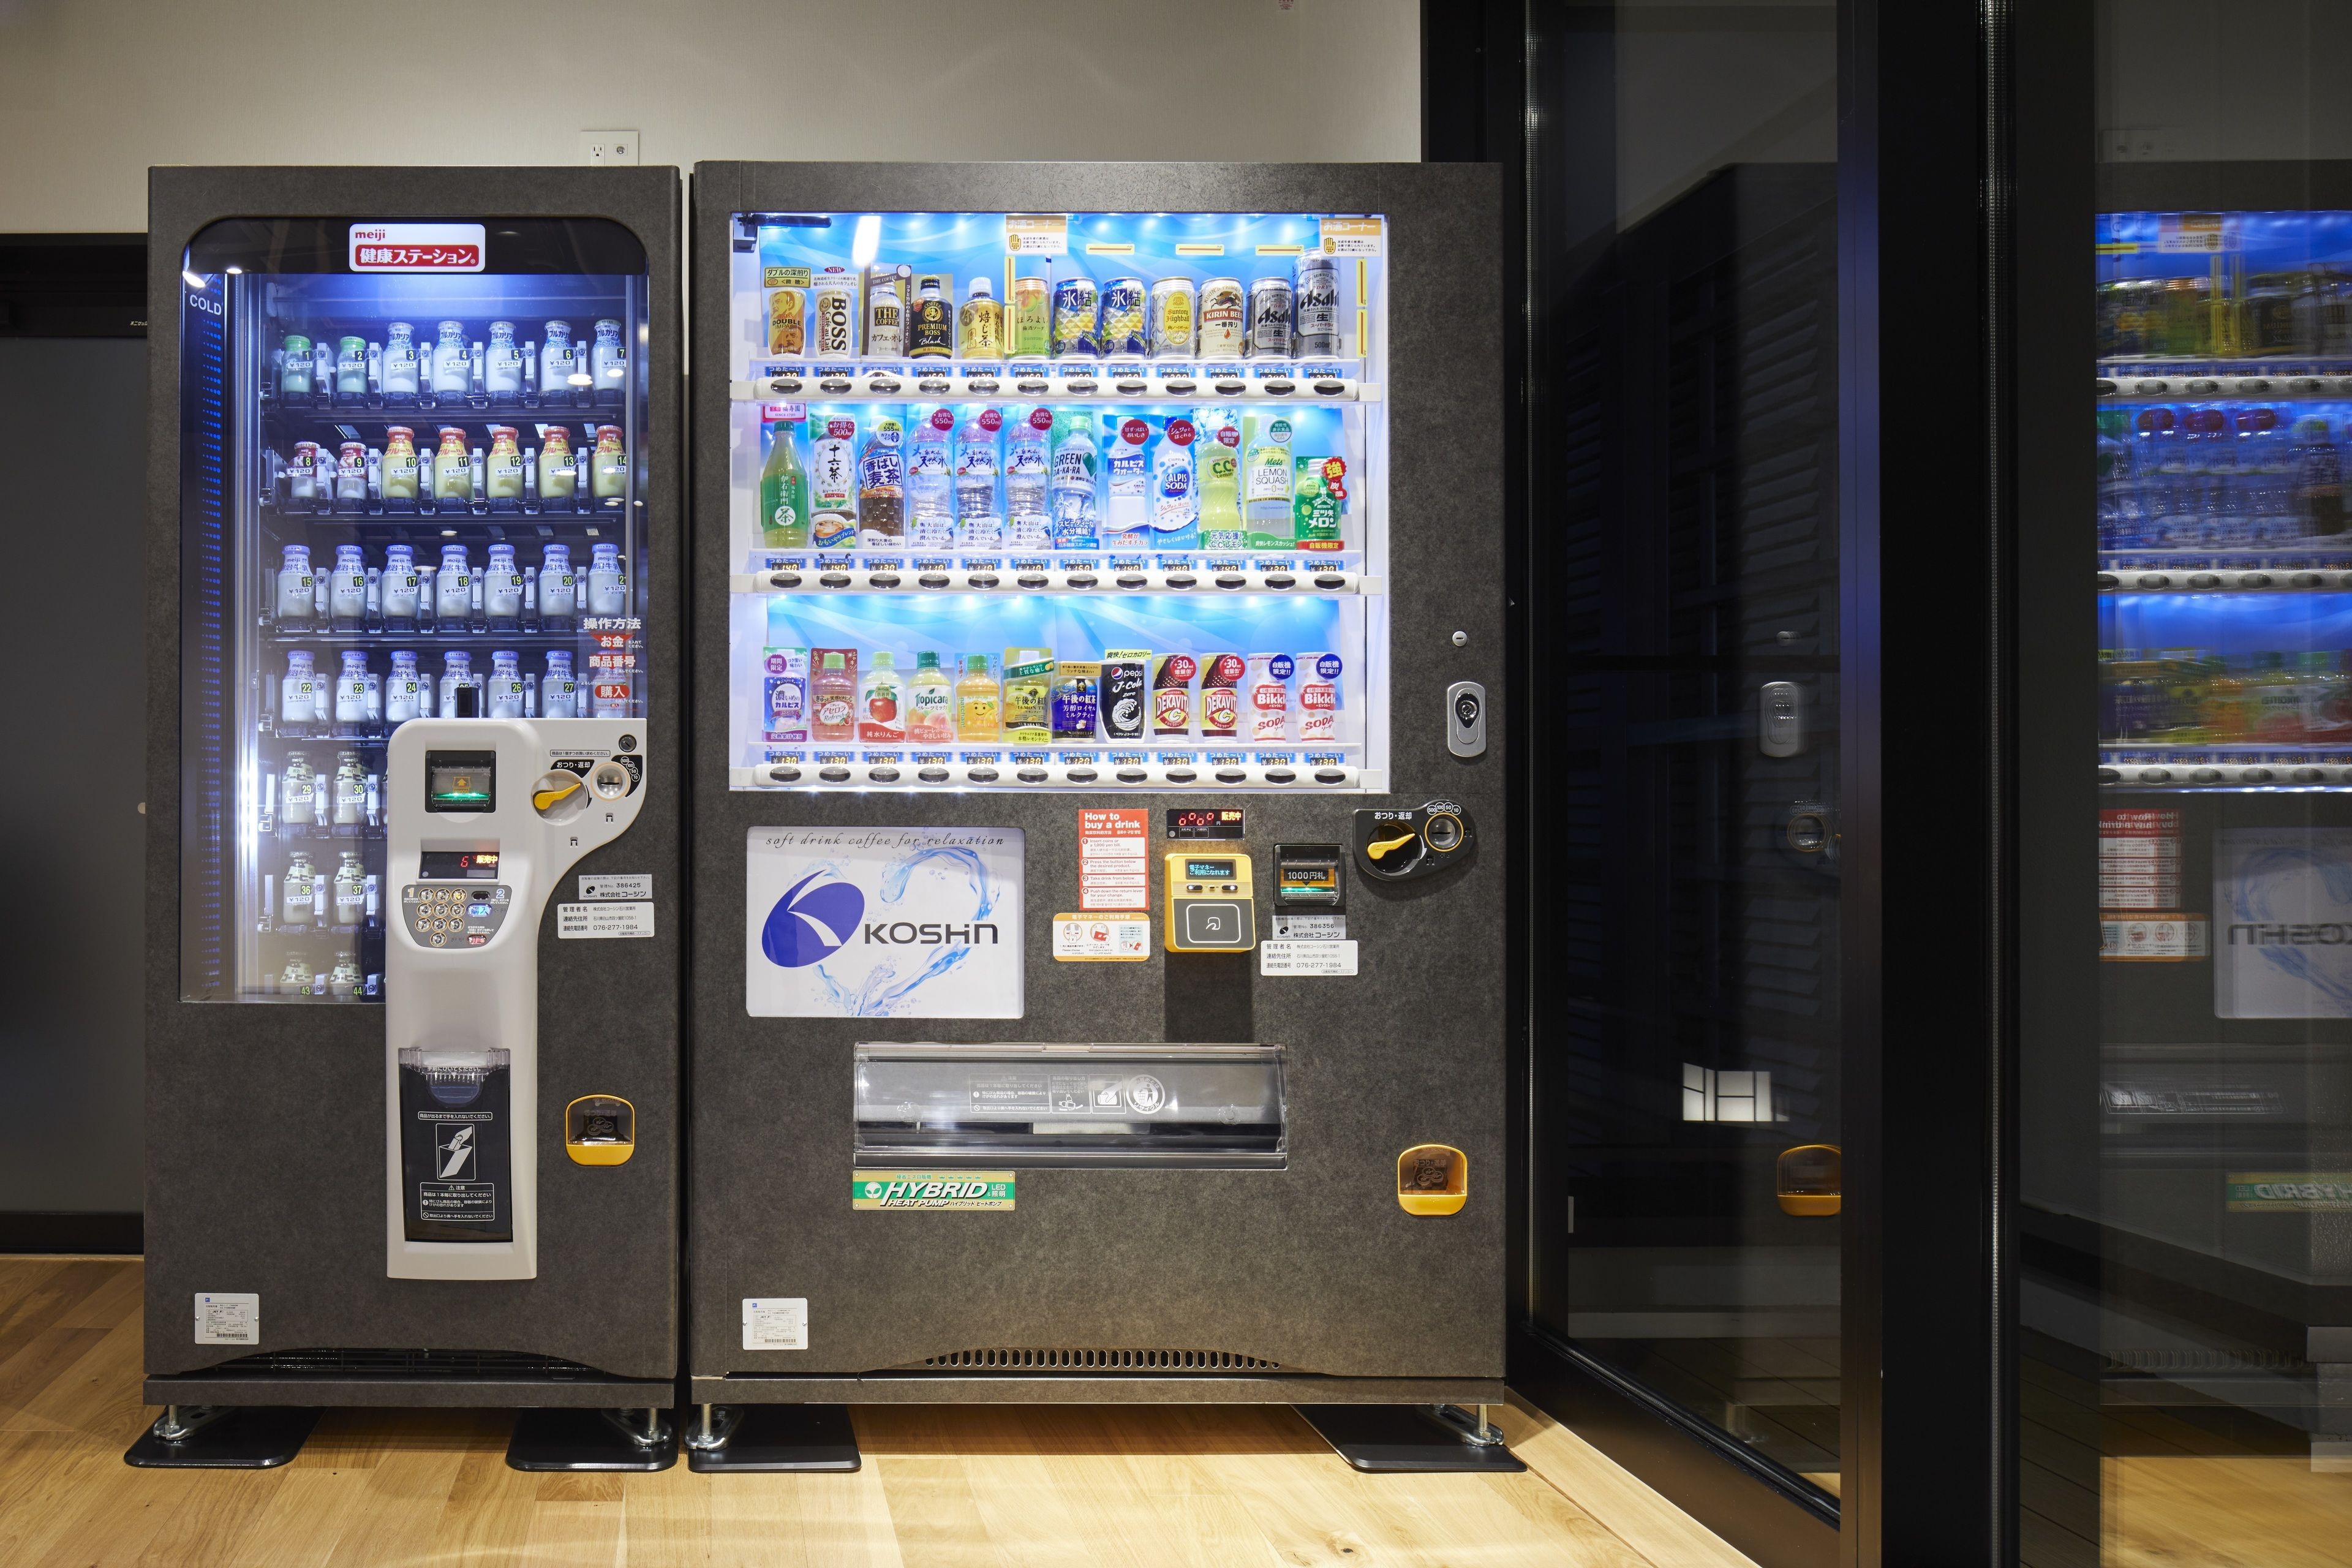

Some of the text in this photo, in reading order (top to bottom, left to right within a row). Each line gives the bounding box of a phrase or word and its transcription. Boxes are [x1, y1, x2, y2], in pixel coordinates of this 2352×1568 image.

[1324, 222, 1376, 232] お酒コーナー
[355, 229, 386, 241] meiji
[360, 247, 472, 264] 健康ステーション
[1062, 291, 1092, 307] 氷結
[1112, 291, 1140, 307] 氷結
[190, 295, 222, 315] COLD
[876, 308, 899, 318] THE
[1167, 309, 1188, 318] Suntory
[831, 296, 846, 351] BOSS
[979, 311, 993, 347] 焙じ茶
[919, 336, 946, 345] Black
[305, 351, 309, 360] 1
[409, 350, 414, 360] 3
[513, 350, 519, 360] 5
[565, 350, 571, 359] 6
[619, 349, 625, 358] 7
[306, 457, 311, 466] 8
[565, 457, 574, 466] 13
[827, 444, 842, 483] 十六茶
[919, 456, 948, 468] 天然水
[966, 456, 995, 469] 天然水
[1015, 456, 1044, 467] 天然水
[1054, 453, 1082, 468] GREEN
[1212, 460, 1234, 474] C.C.
[1325, 462, 1343, 478] 強
[868, 469, 900, 486] 麦茶
[1165, 473, 1186, 483] CALPIS
[1165, 481, 1186, 490] SODA
[777, 508, 794, 523] 茶
[1309, 518, 1337, 528] メロン
[818, 530, 854, 546] おもいやりブレンド
[407, 577, 417, 586] 17
[583, 617, 641, 630] 操作方法
[600, 636, 624, 647] お金
[589, 655, 636, 668] 商品番号
[1124, 669, 1143, 678] pepsi
[407, 684, 417, 692] 24
[1112, 678, 1142, 693] J-Cola
[600, 686, 625, 698] 購入
[775, 690, 799, 701] 濃いめの
[915, 693, 948, 707] Tropicana
[1062, 695, 1096, 704] 午後の紅茶
[823, 706, 846, 714] アセロラ
[1169, 708, 1181, 721] C
[824, 713, 845, 722] Refresh
[1305, 715, 1334, 730] SODA
[302, 785, 311, 794] 29
[1221, 812, 1242, 821] 販売中
[1085, 821, 1102, 829] buy
[766, 832, 1005, 848] soft drink coffee for relaxation
[353, 886, 362, 894] 37
[407, 888, 415, 898] 1
[496, 889, 505, 899] 2
[864, 922, 998, 944] KOSHIN
[880, 1182, 989, 1207] HYBRID
